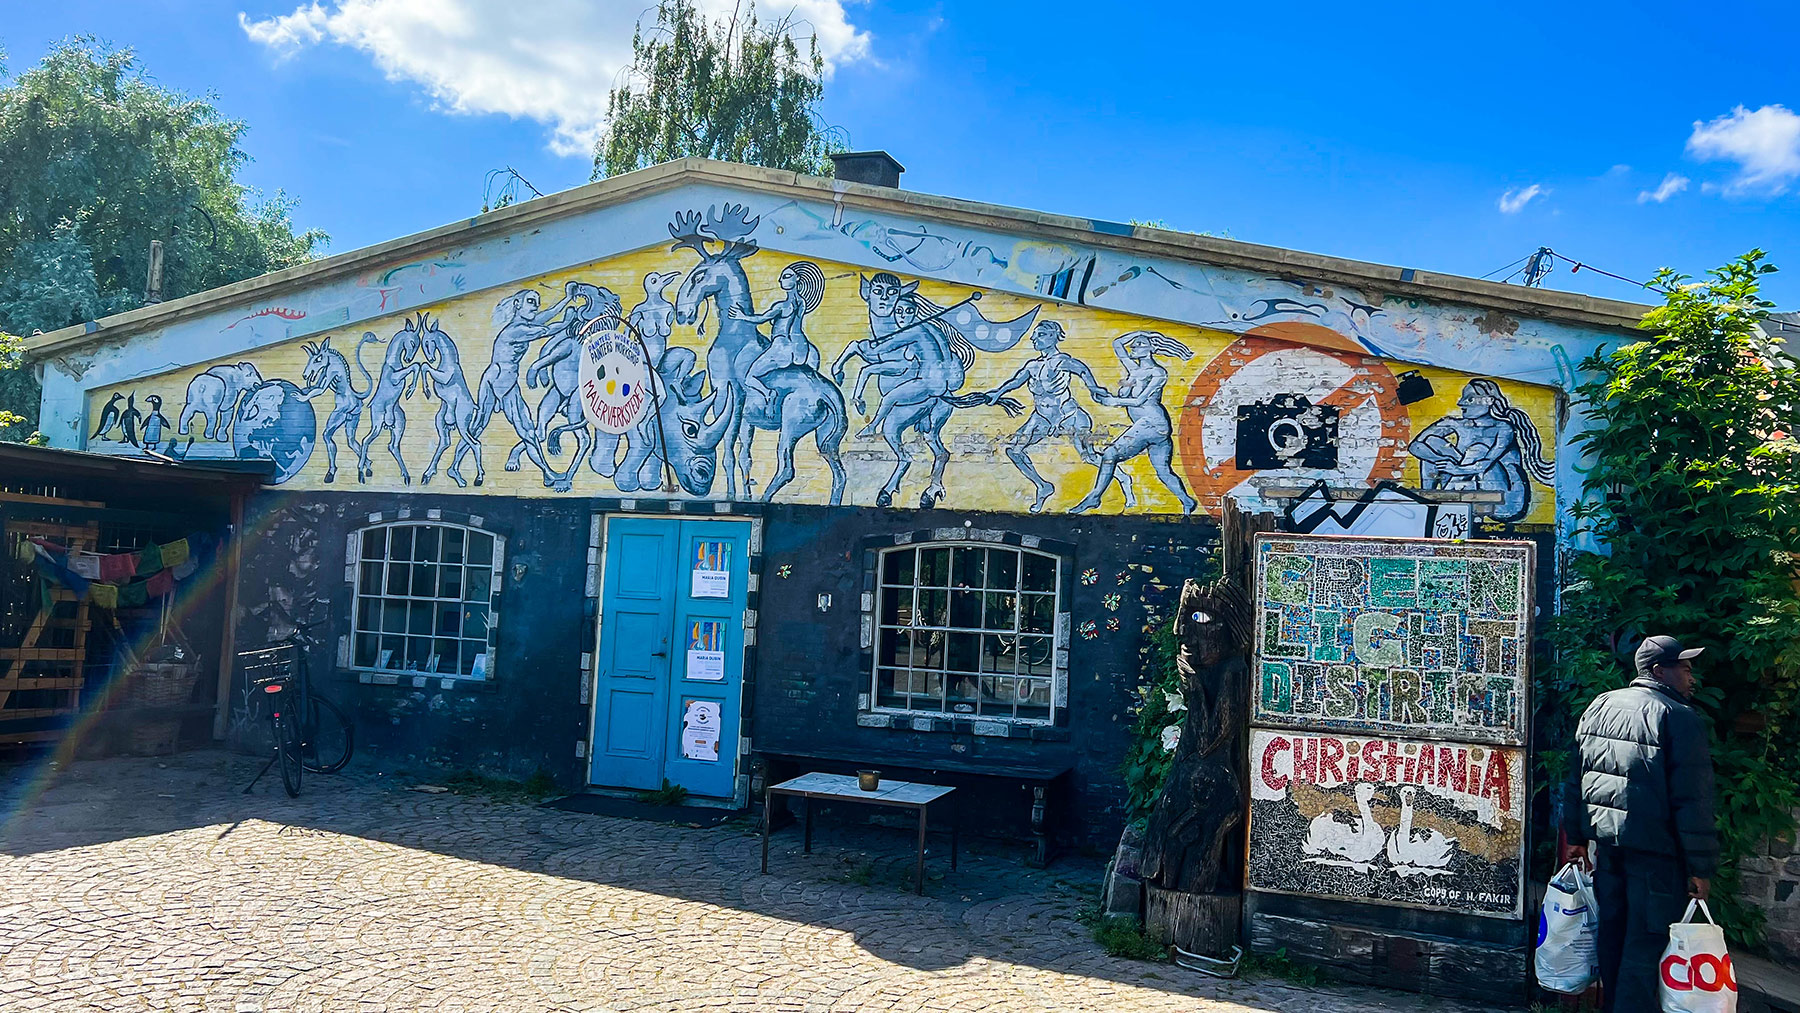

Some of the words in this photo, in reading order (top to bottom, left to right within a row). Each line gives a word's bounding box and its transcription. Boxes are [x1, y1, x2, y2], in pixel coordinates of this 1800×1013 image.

[588, 333, 610, 353] PAINTERS
[590, 341, 613, 364] PAINTERS
[615, 342, 640, 366] WORKSHOP
[584, 379, 645, 428] MALERVÆRKSTEDET
[1265, 555, 1519, 615] GREEN
[1262, 609, 1518, 675] LIGHT
[1261, 660, 1516, 729] DISTRICT
[1449, 889, 1461, 899] OF
[1479, 892, 1511, 904] FAKIR
